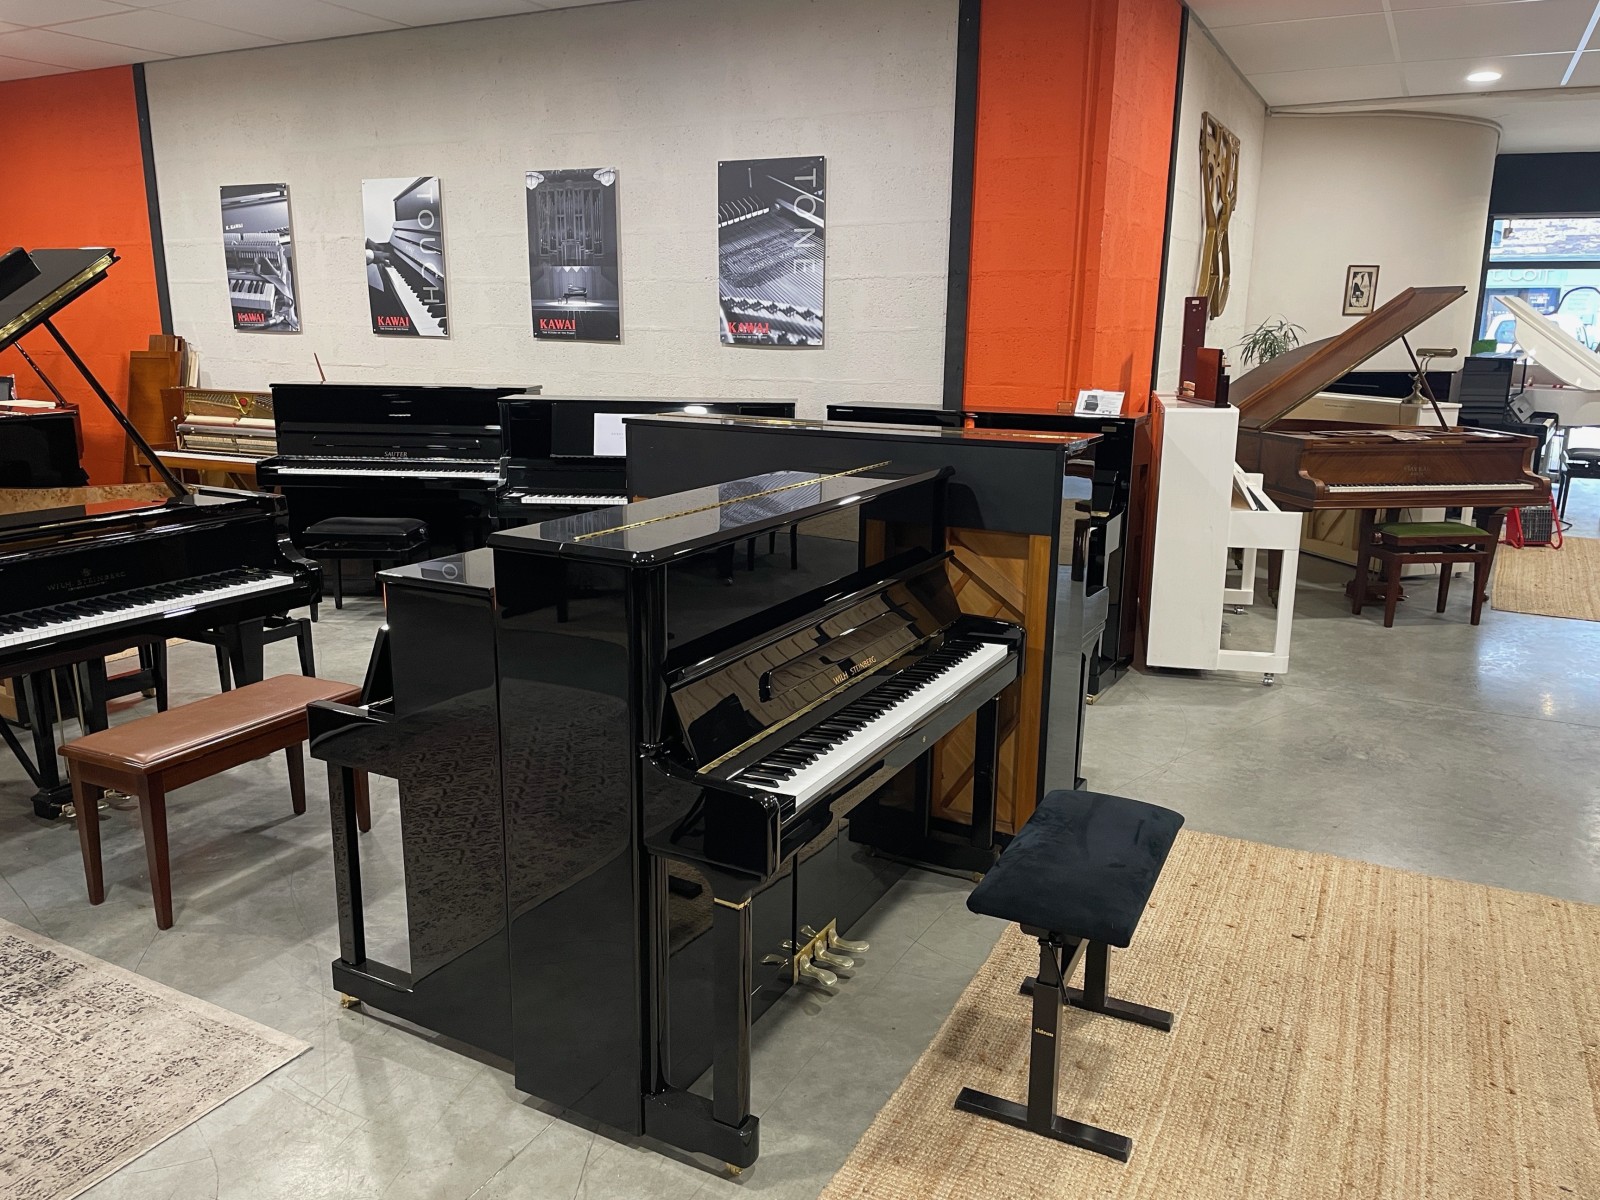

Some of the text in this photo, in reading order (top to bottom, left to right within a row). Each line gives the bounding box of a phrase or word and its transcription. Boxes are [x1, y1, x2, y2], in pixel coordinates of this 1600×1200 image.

[793, 167, 817, 273] TONE
[416, 186, 440, 303] TOUCH
[237, 312, 265, 322] KAWAI
[377, 316, 409, 326] KAWAI
[540, 319, 576, 330] KAWAI
[728, 322, 769, 334] KAWAI
